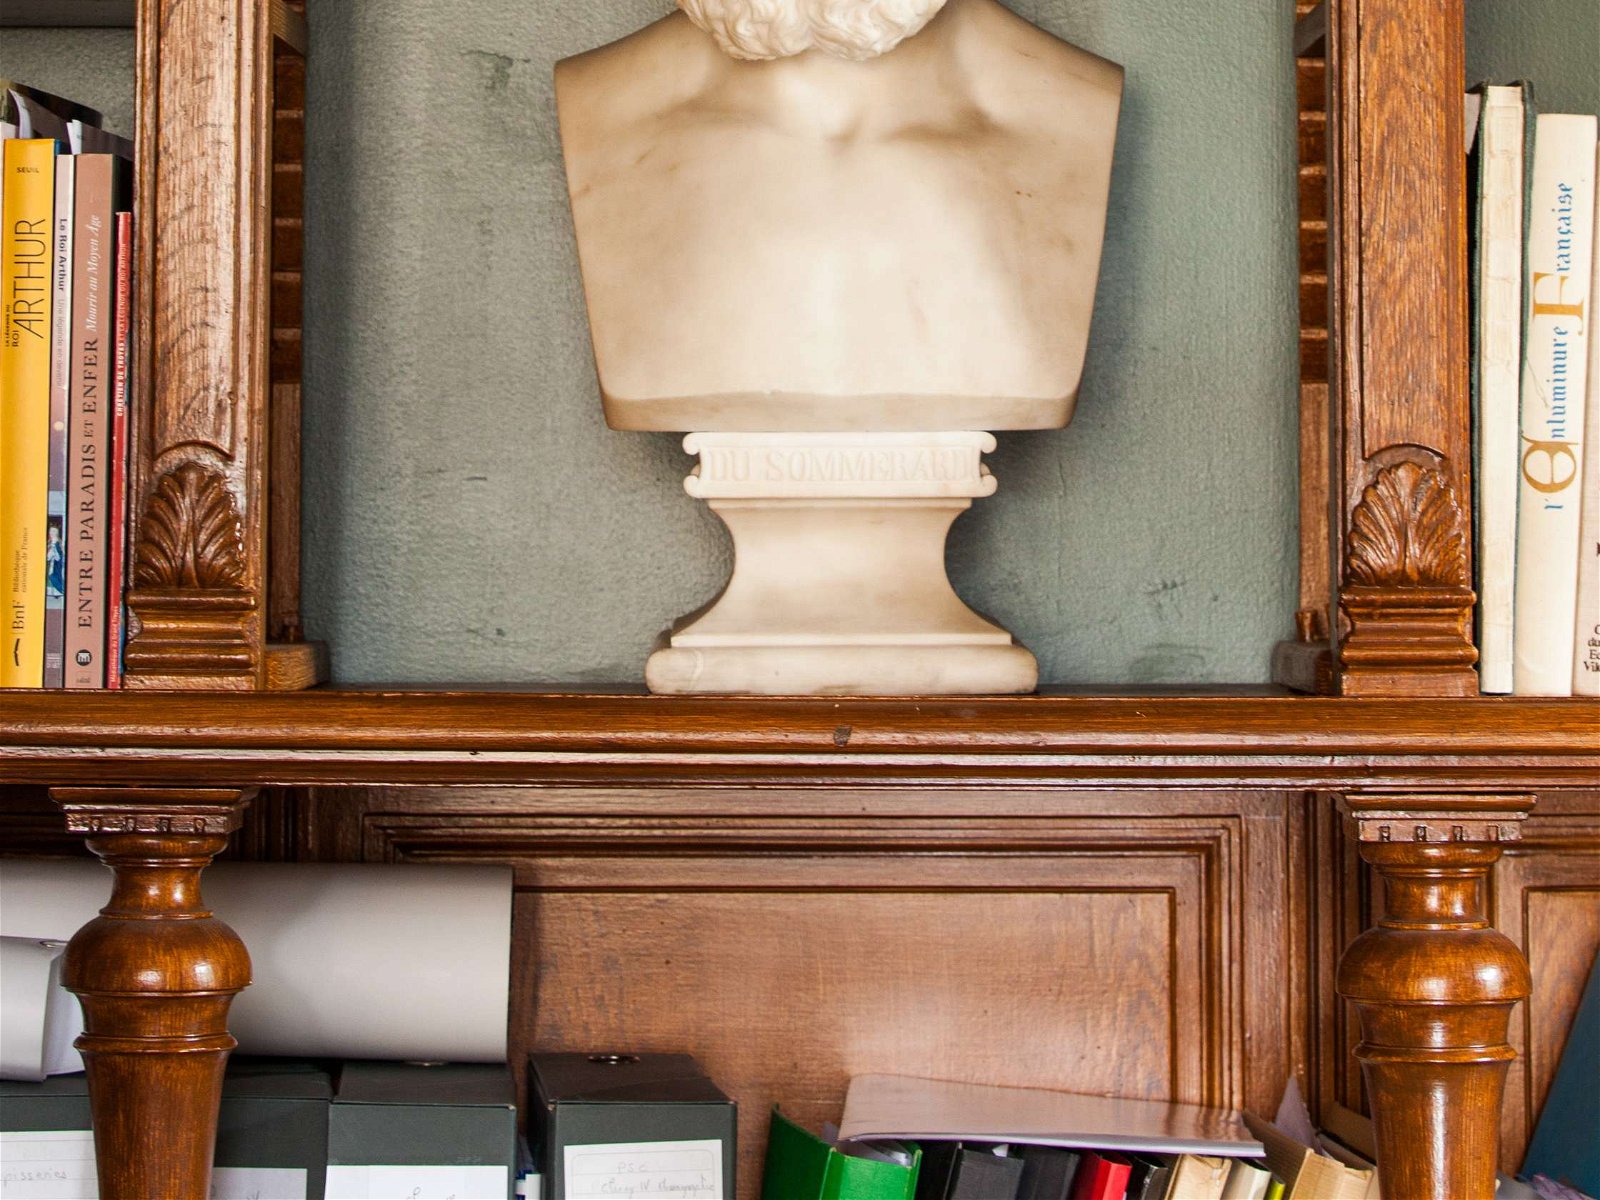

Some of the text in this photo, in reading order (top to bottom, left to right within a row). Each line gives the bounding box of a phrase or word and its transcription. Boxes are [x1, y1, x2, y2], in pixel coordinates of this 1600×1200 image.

[16, 166, 40, 174] SEUIL
[59, 234, 68, 252] Roi
[86, 238, 102, 274] Moyen
[11, 217, 47, 348] ROI ARTHUR
[58, 255, 68, 292] Arthur
[88, 277, 99, 291] au
[85, 293, 98, 332] Mourir
[82, 337, 98, 414] ENFER
[83, 420, 94, 438] ET
[709, 449, 753, 482] DU
[79, 444, 97, 542] PARADIS
[78, 549, 94, 629] ENTRE
[11, 599, 25, 630] BnF
